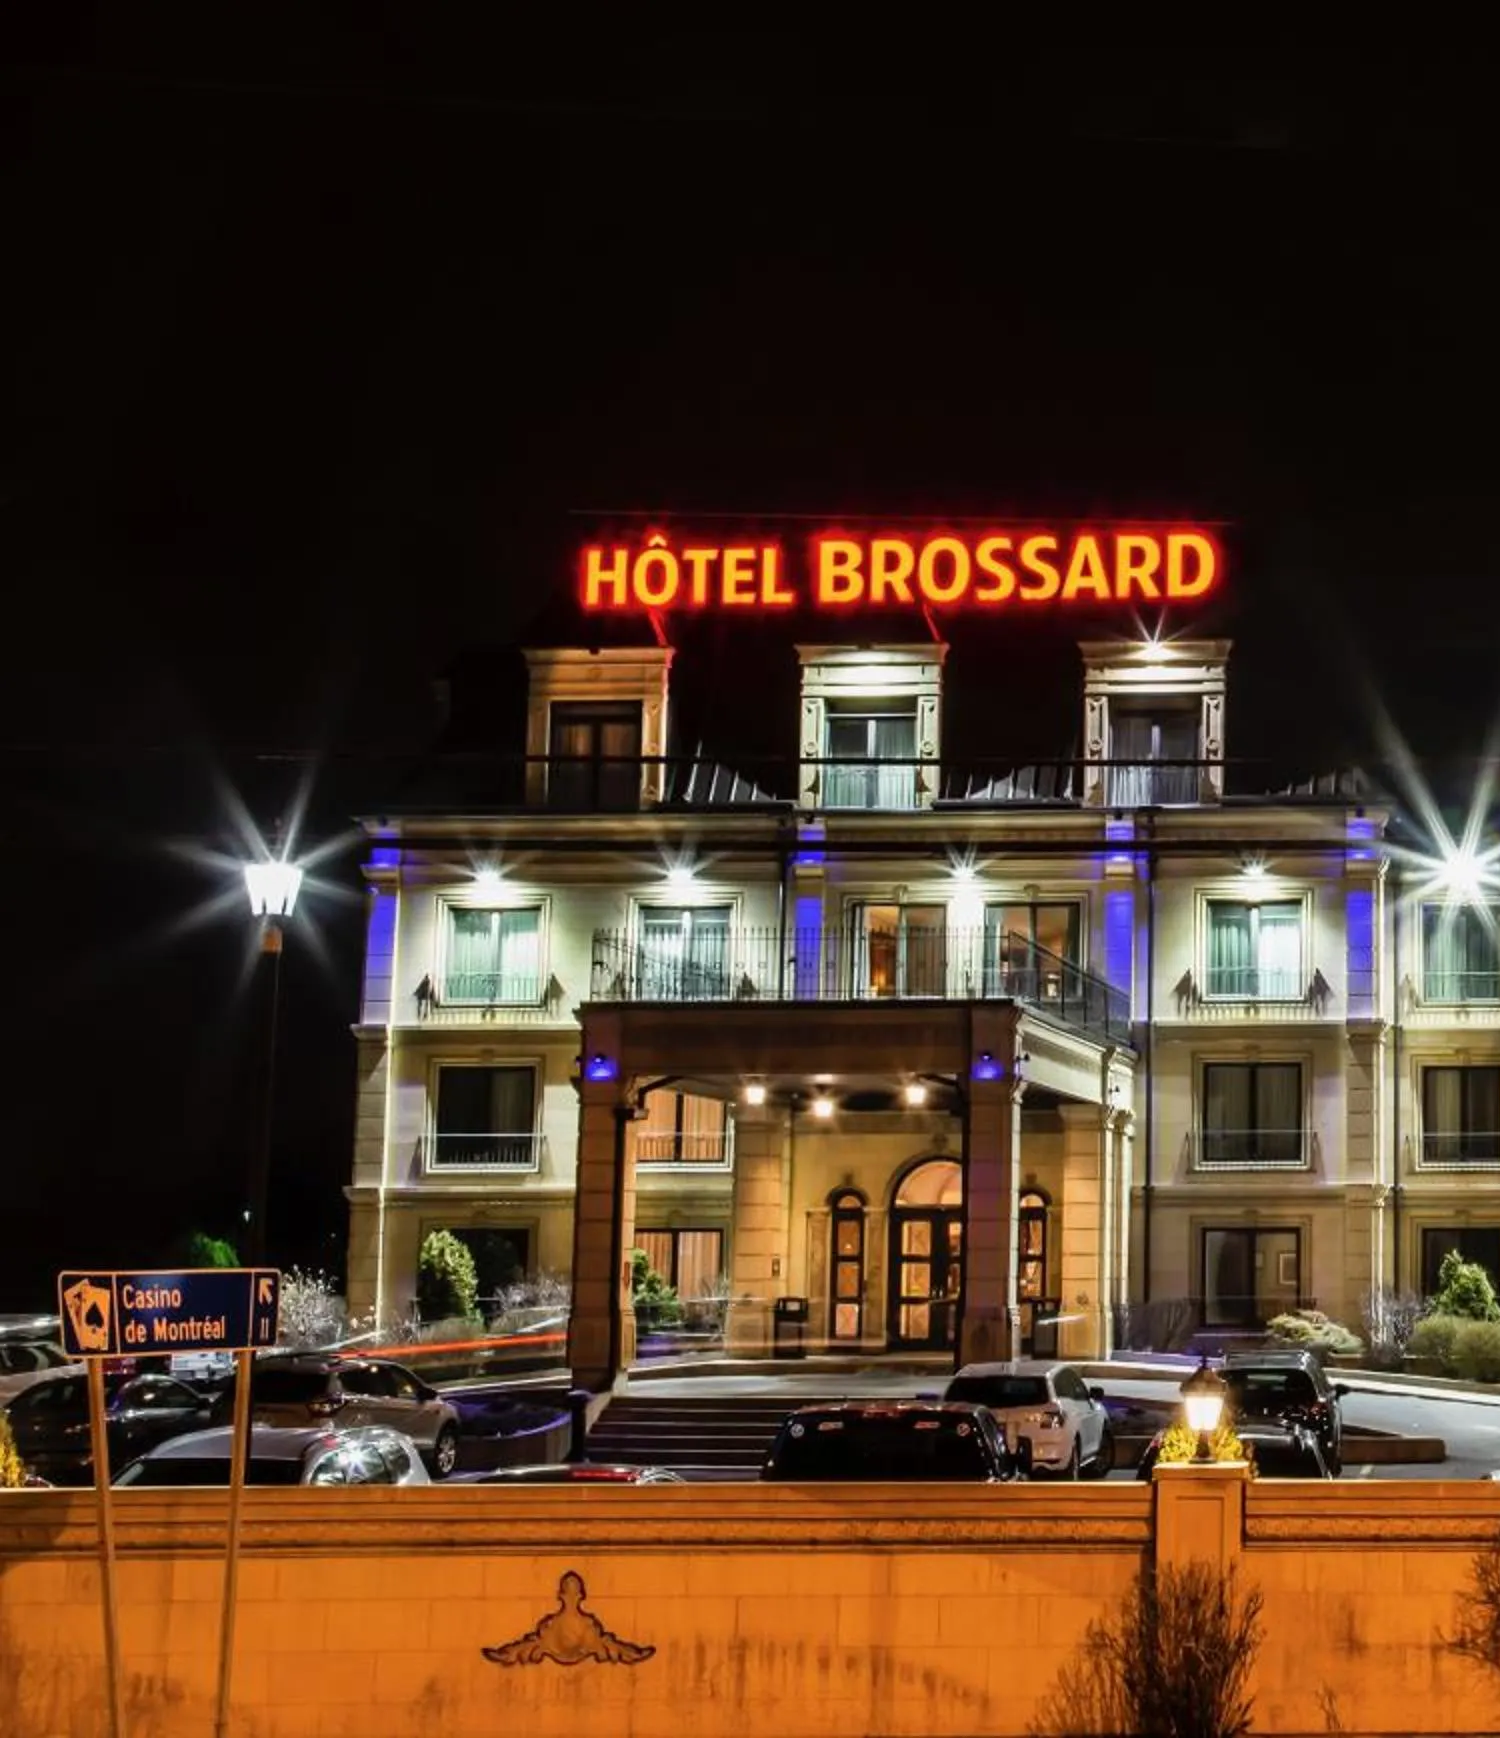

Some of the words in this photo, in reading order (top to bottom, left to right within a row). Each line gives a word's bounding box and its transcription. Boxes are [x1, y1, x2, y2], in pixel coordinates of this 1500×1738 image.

[585, 534, 795, 605] HÔTEL
[818, 533, 1216, 602] BROSSARD
[122, 1284, 182, 1310] Casino
[125, 1320, 147, 1344] de
[153, 1315, 226, 1343] Montréal
